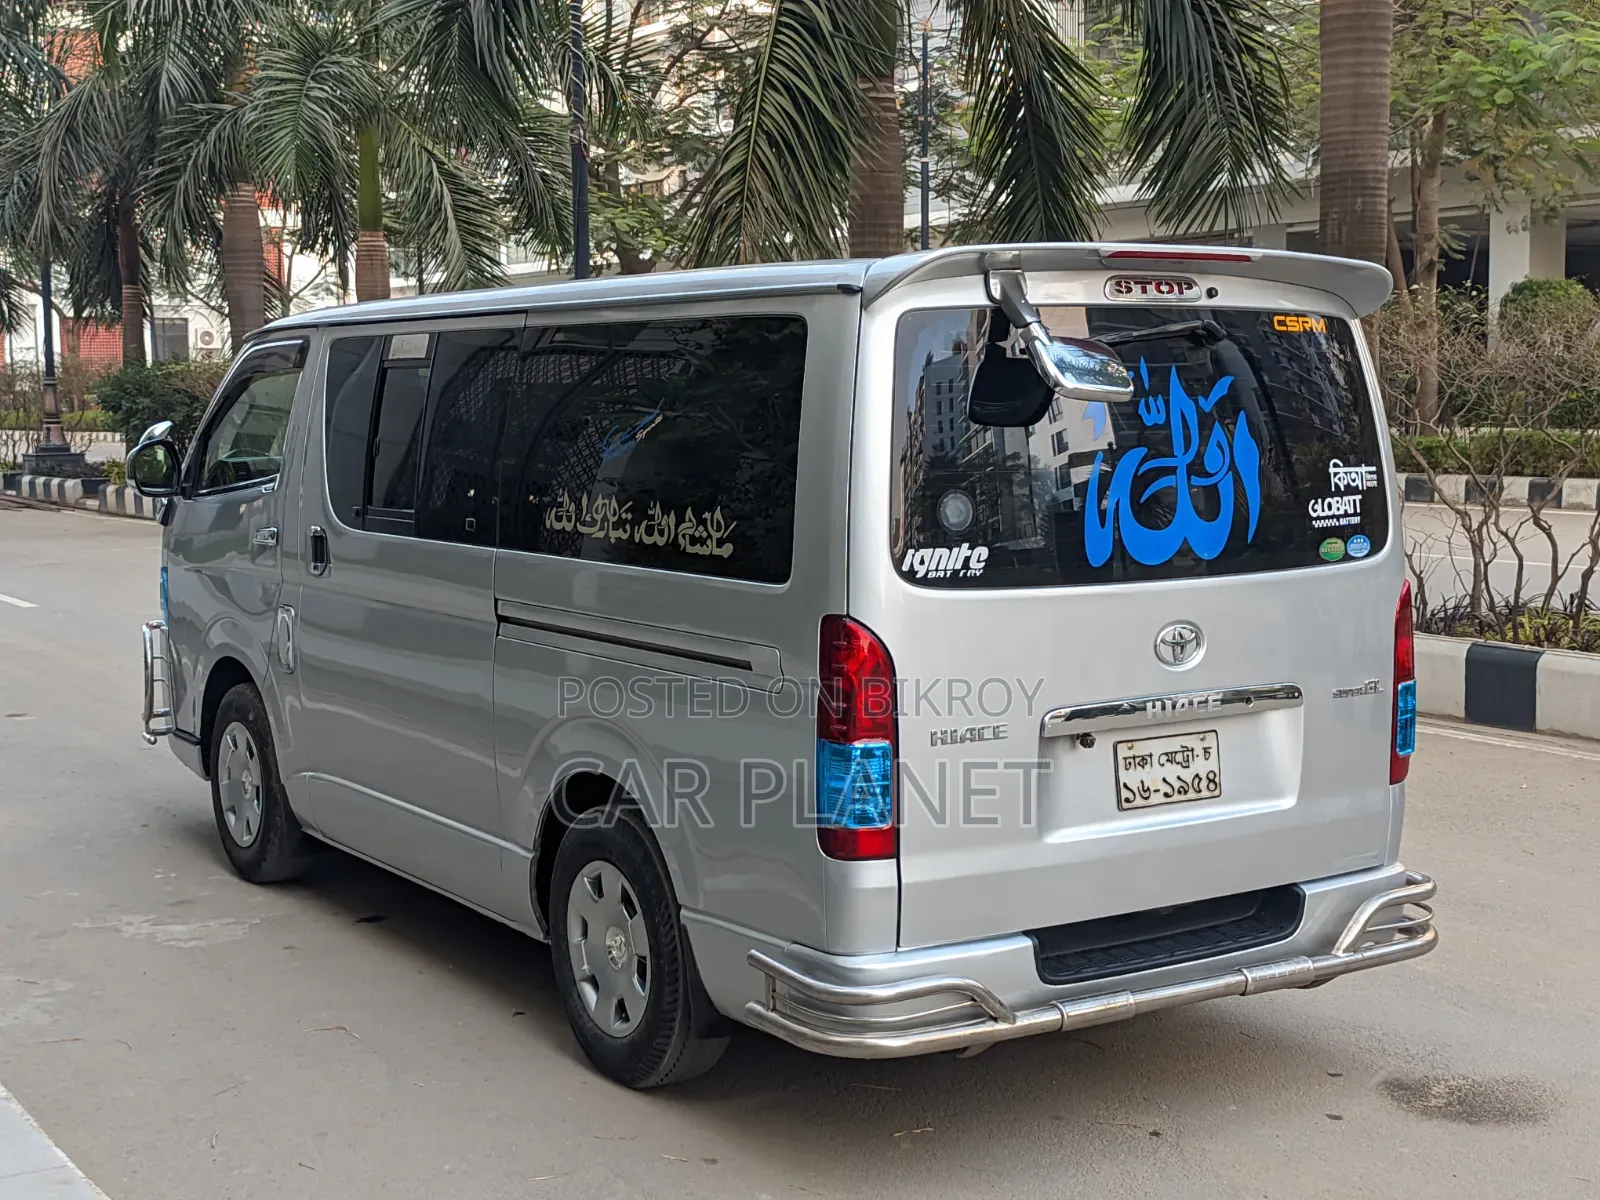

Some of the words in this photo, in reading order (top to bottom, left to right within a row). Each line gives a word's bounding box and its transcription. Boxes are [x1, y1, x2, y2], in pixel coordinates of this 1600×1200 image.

[1114, 279, 1194, 295] STOP
[1273, 315, 1327, 333] CSRM
[1308, 495, 1362, 517] GLOBATT
[1145, 693, 1224, 719] HIACE
[930, 722, 1009, 747] HIACE
[1122, 752, 1153, 771] ঢাকা
[1122, 770, 1218, 804] ১৬-১৯৫৪
